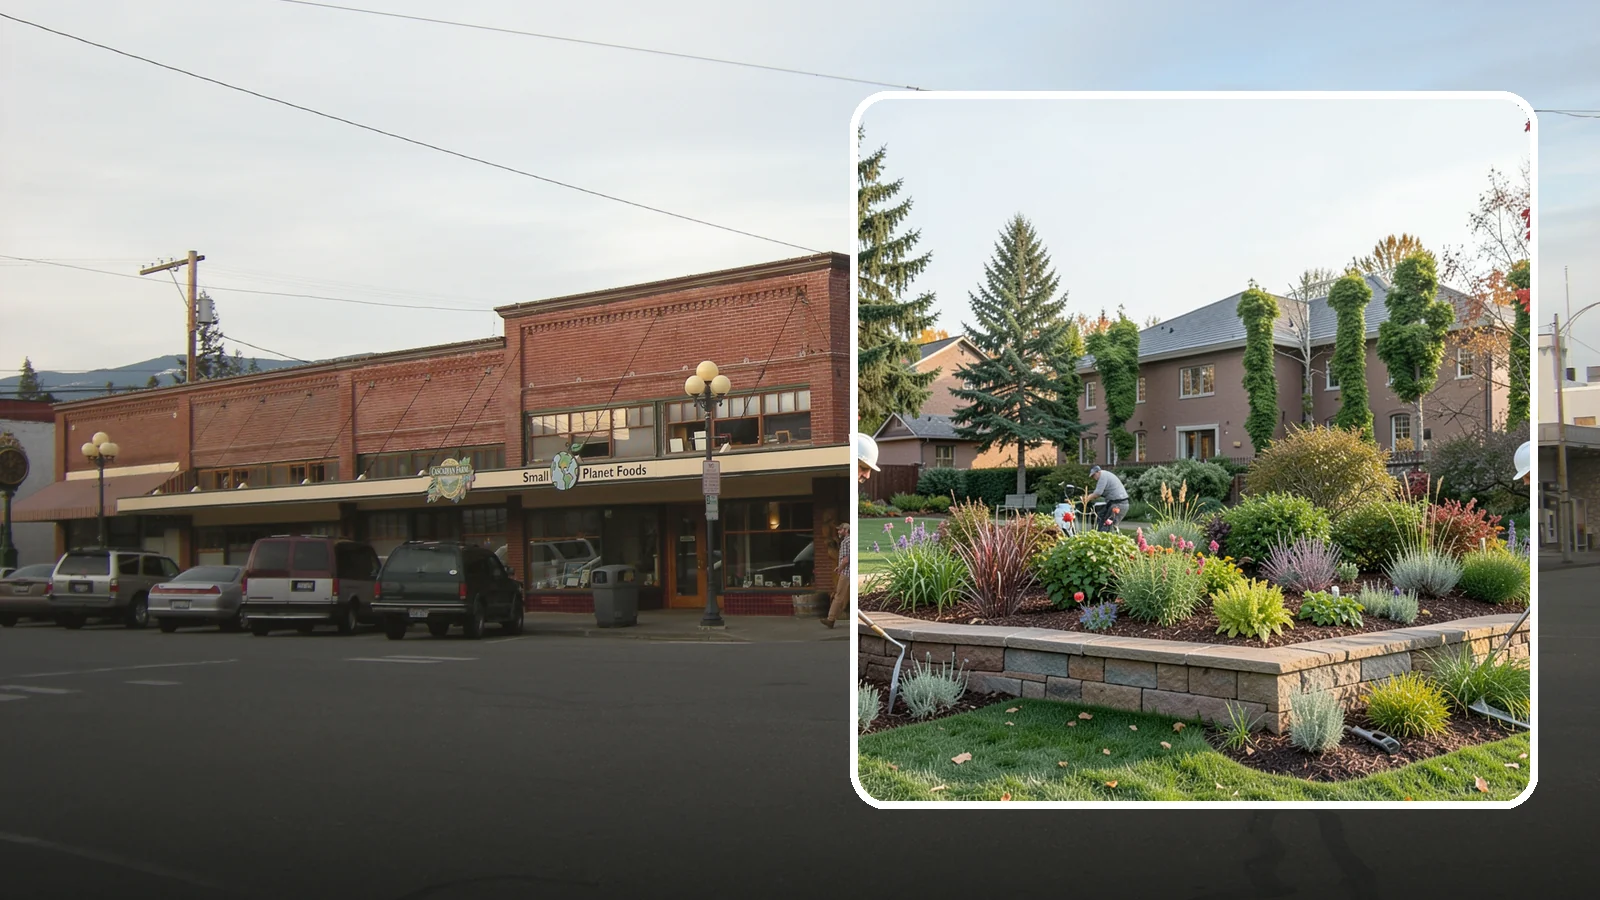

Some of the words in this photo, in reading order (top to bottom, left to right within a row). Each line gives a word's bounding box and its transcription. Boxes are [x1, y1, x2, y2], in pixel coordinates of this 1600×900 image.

[523, 470, 549, 483] Small
[583, 467, 614, 479] Planet
[617, 464, 647, 477] Foods
